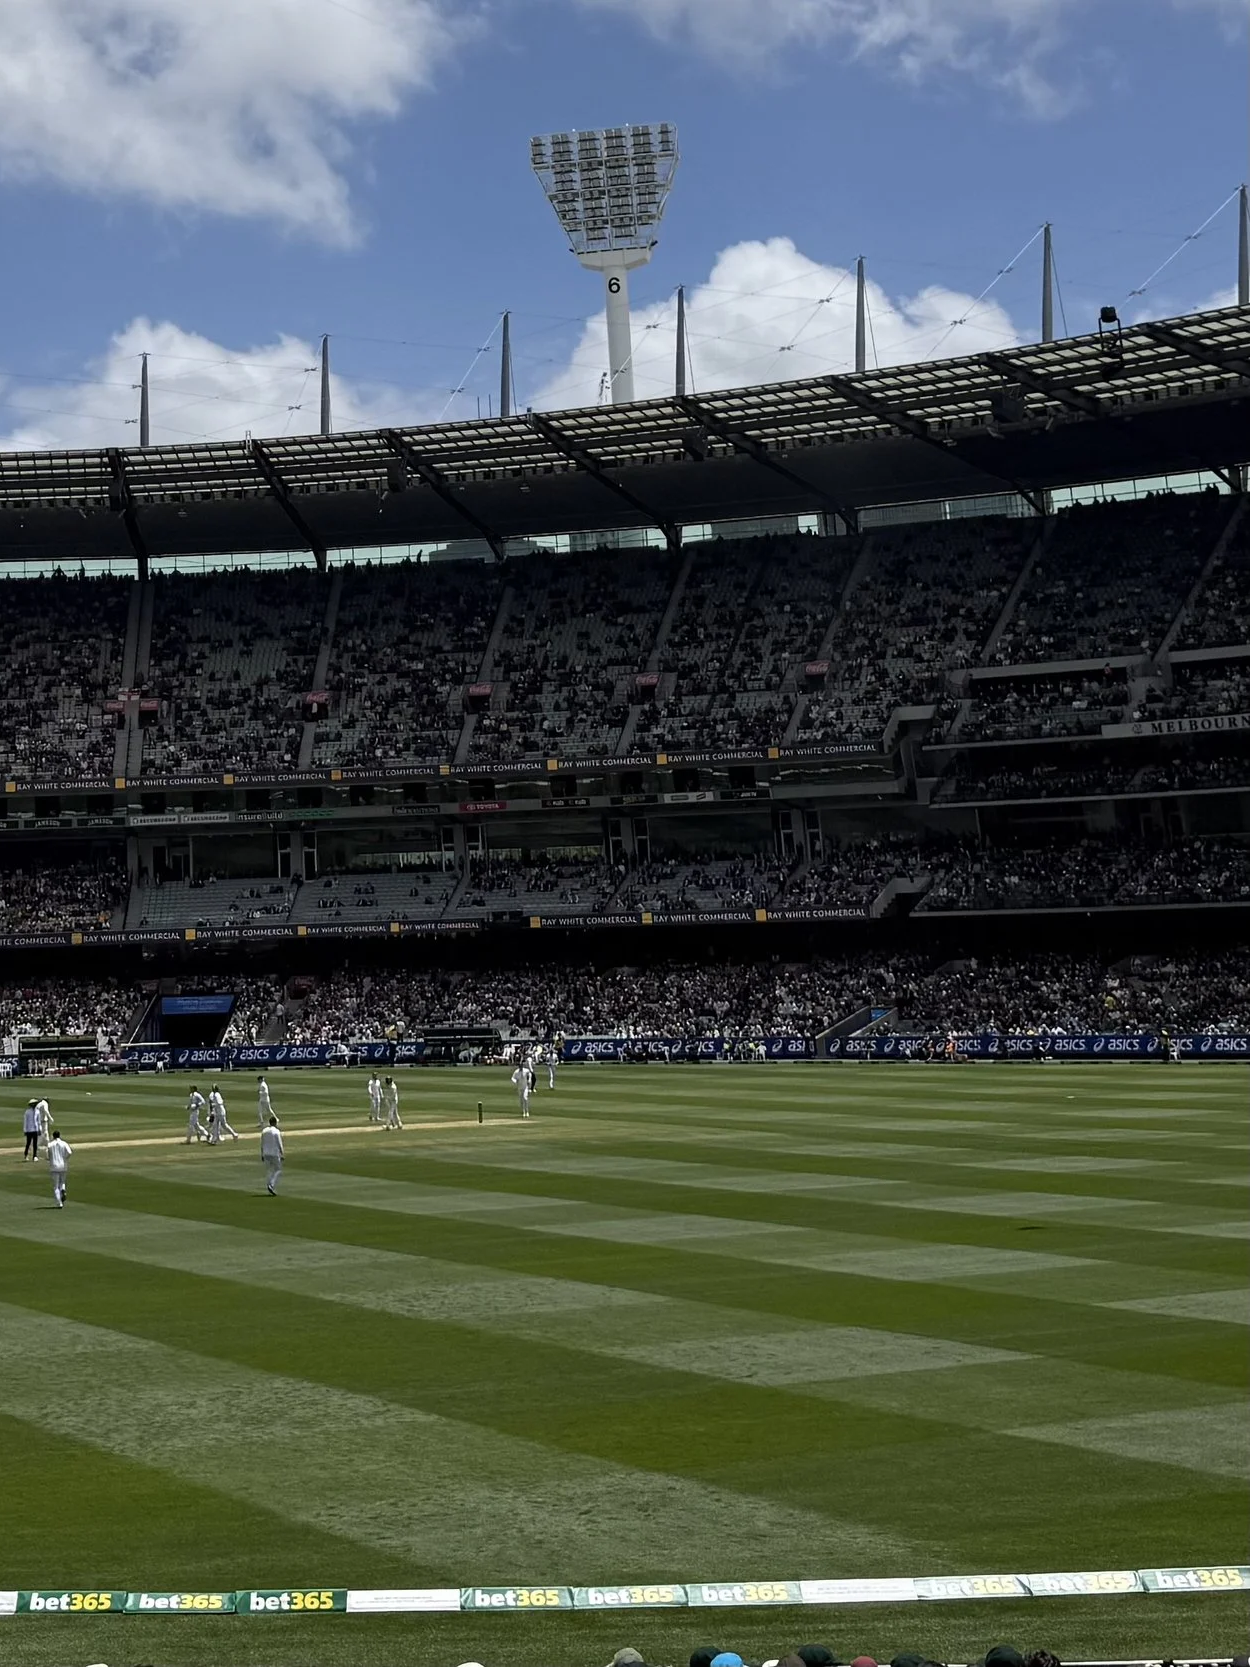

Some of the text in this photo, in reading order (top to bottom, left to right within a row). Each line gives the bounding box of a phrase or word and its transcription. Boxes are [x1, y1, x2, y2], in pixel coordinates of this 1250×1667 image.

[608, 276, 621, 294] 6
[668, 750, 764, 763] RAY WHITE COMMERCIAL
[780, 744, 877, 757] RAY WHITE COMMERCIAL
[451, 762, 542, 774] RAY WHITE COMMERCIAL
[558, 756, 652, 768] RAY WHITE COMMERCIAL
[234, 772, 326, 783] RAY WHITE COMMERCIAL
[342, 767, 435, 778] RAY WHITE COMMERCIAL
[126, 777, 219, 787] RAY WHITE COMMERCIAL
[653, 912, 751, 923] RAY WHITE COMMERCIAL
[767, 908, 866, 919] RAY WHITE COMMERCIAL
[541, 915, 638, 926] RAY WHITE COMMERCIAL
[197, 928, 294, 938] RAY WHITE COMMERCIAL
[14, 936, 66, 946] COMMERCIAL
[1045, 1574, 1131, 1592] bet365
[1156, 1570, 1244, 1589] bet365
[701, 1585, 788, 1602] bet365
[931, 1578, 1016, 1596] bet365
[30, 1593, 112, 1610] bet365
[139, 1593, 223, 1610] bet365
[250, 1592, 333, 1610] bet365
[474, 1590, 560, 1606] bet365
[588, 1588, 674, 1605] bet365
